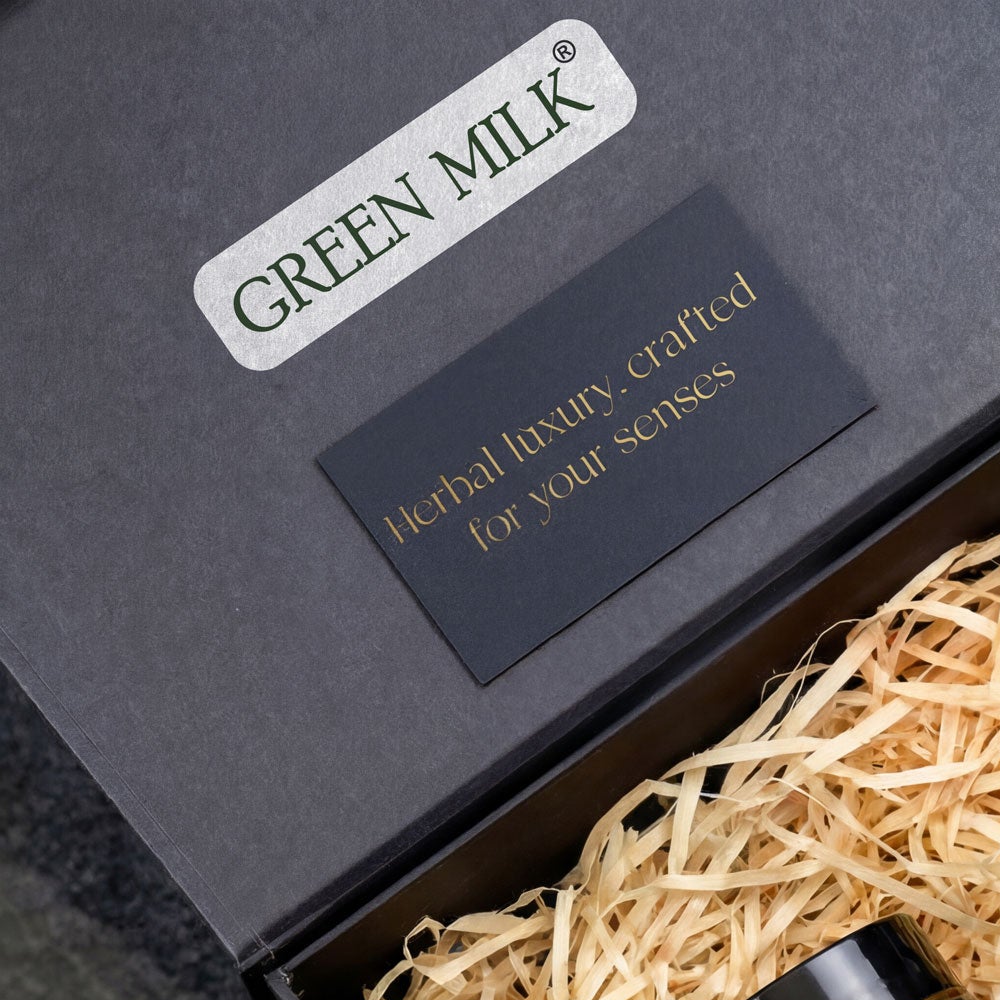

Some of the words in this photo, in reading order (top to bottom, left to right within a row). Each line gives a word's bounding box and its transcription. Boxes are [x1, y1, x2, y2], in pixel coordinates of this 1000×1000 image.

[233, 171, 435, 332] GREEN
[383, 445, 505, 545] Herbal
[628, 271, 758, 380] crafted
[468, 503, 523, 552] for
[528, 445, 607, 526] your
[613, 357, 736, 455] senses
